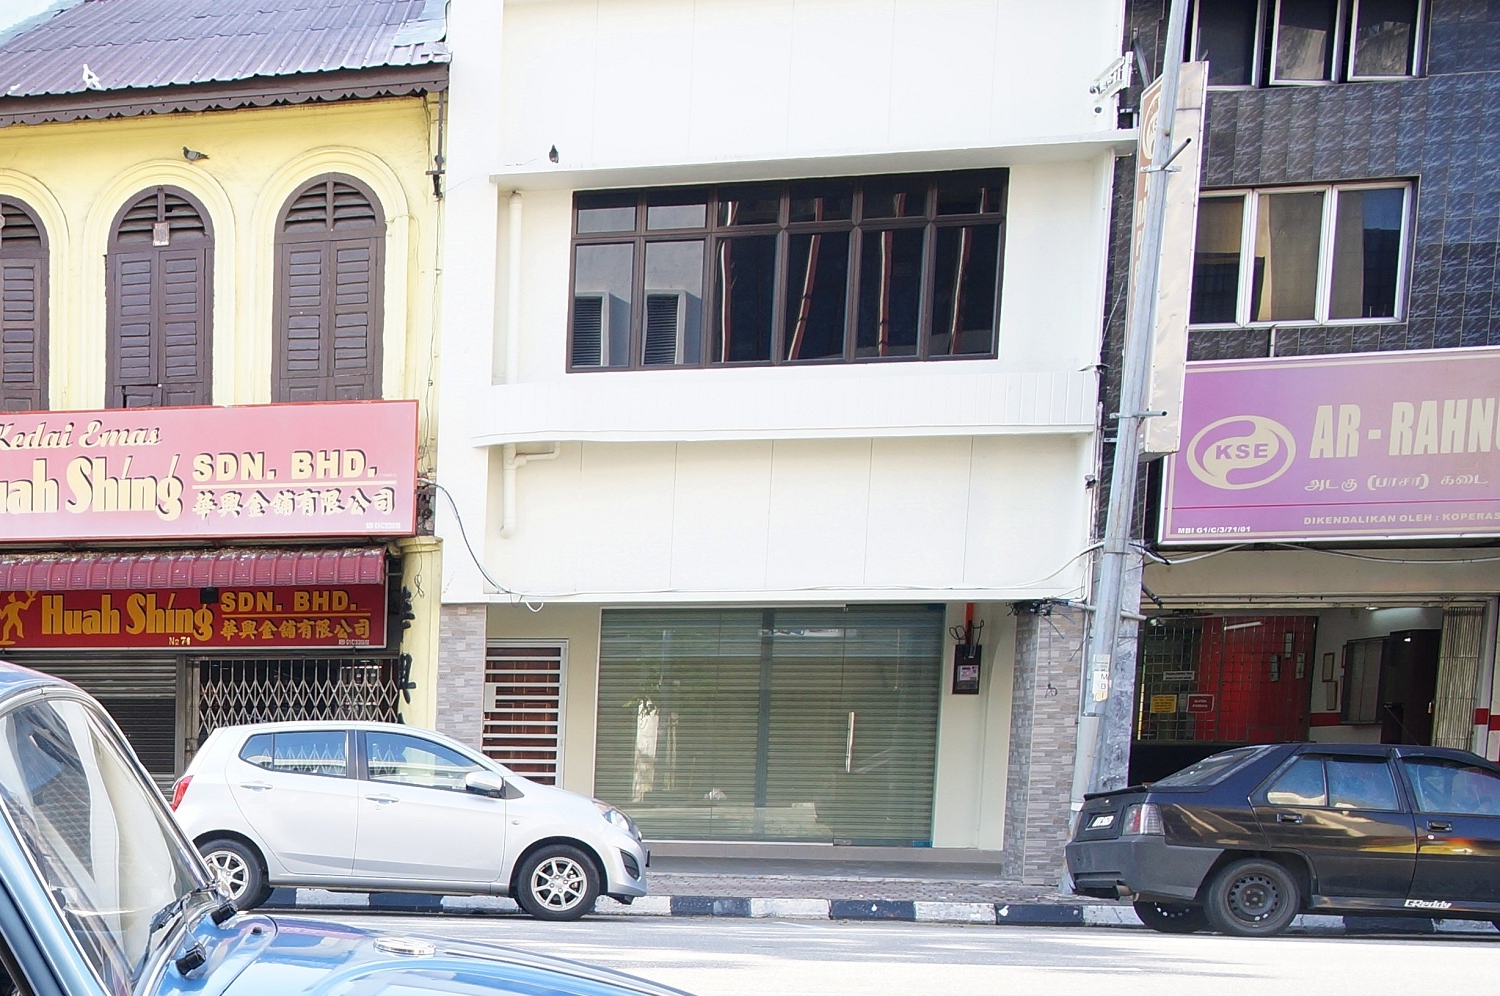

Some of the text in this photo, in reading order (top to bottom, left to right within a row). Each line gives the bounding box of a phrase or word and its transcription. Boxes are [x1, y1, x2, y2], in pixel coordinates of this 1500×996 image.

[77, 419, 163, 449] Emas
[1214, 442, 1270, 461] KSE
[192, 449, 378, 482] SDN. BHD.
[65, 453, 184, 522] Shing
[1303, 514, 1396, 525] DIKENDALIKAN
[1399, 513, 1432, 523] OLEH
[220, 590, 358, 613] SDN. BHD.
[41, 591, 215, 642] Huah Shing
[1403, 899, 1453, 909] GReddy
